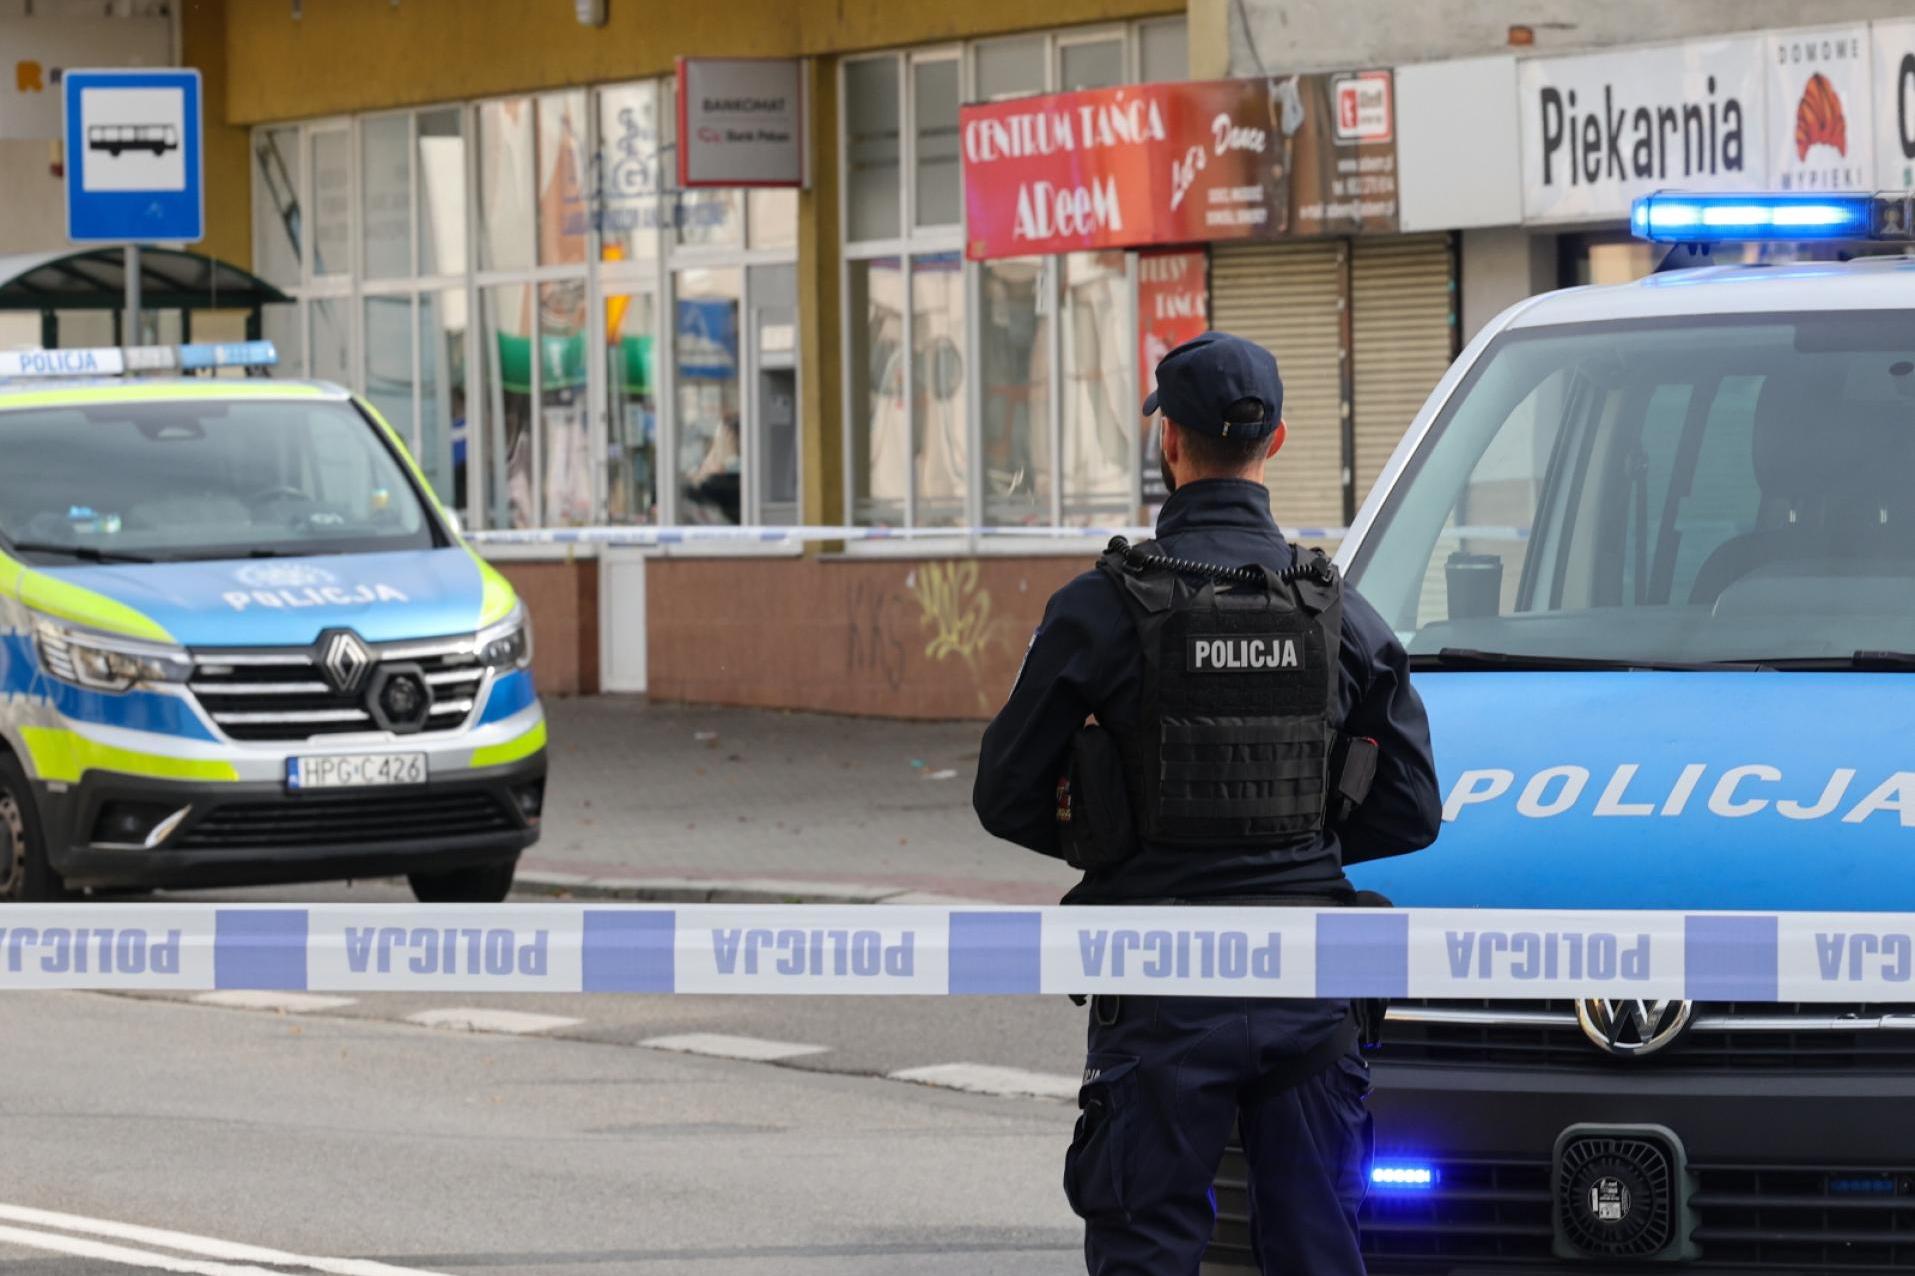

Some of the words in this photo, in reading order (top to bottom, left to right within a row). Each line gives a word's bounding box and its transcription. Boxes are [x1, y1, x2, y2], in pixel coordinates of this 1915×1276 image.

[1779, 38, 1858, 65] DOMOWE
[965, 111, 1075, 163] CENTRUM
[1078, 90, 1166, 148] TAŃCA
[1541, 75, 1744, 186] Piekarnia
[20, 351, 98, 373] POLICJA
[221, 583, 410, 612] POLICJA
[1195, 639, 1298, 668] POLICJA
[304, 758, 352, 787] HPG
[361, 757, 421, 783] C426
[1441, 763, 1915, 827] POLICJA
[0, 928, 182, 974] POLICJ
[346, 928, 549, 976] POLICJA
[712, 929, 915, 977] POLICJA
[1077, 931, 1282, 979] POLICJA
[1445, 931, 1652, 981] POLICJA
